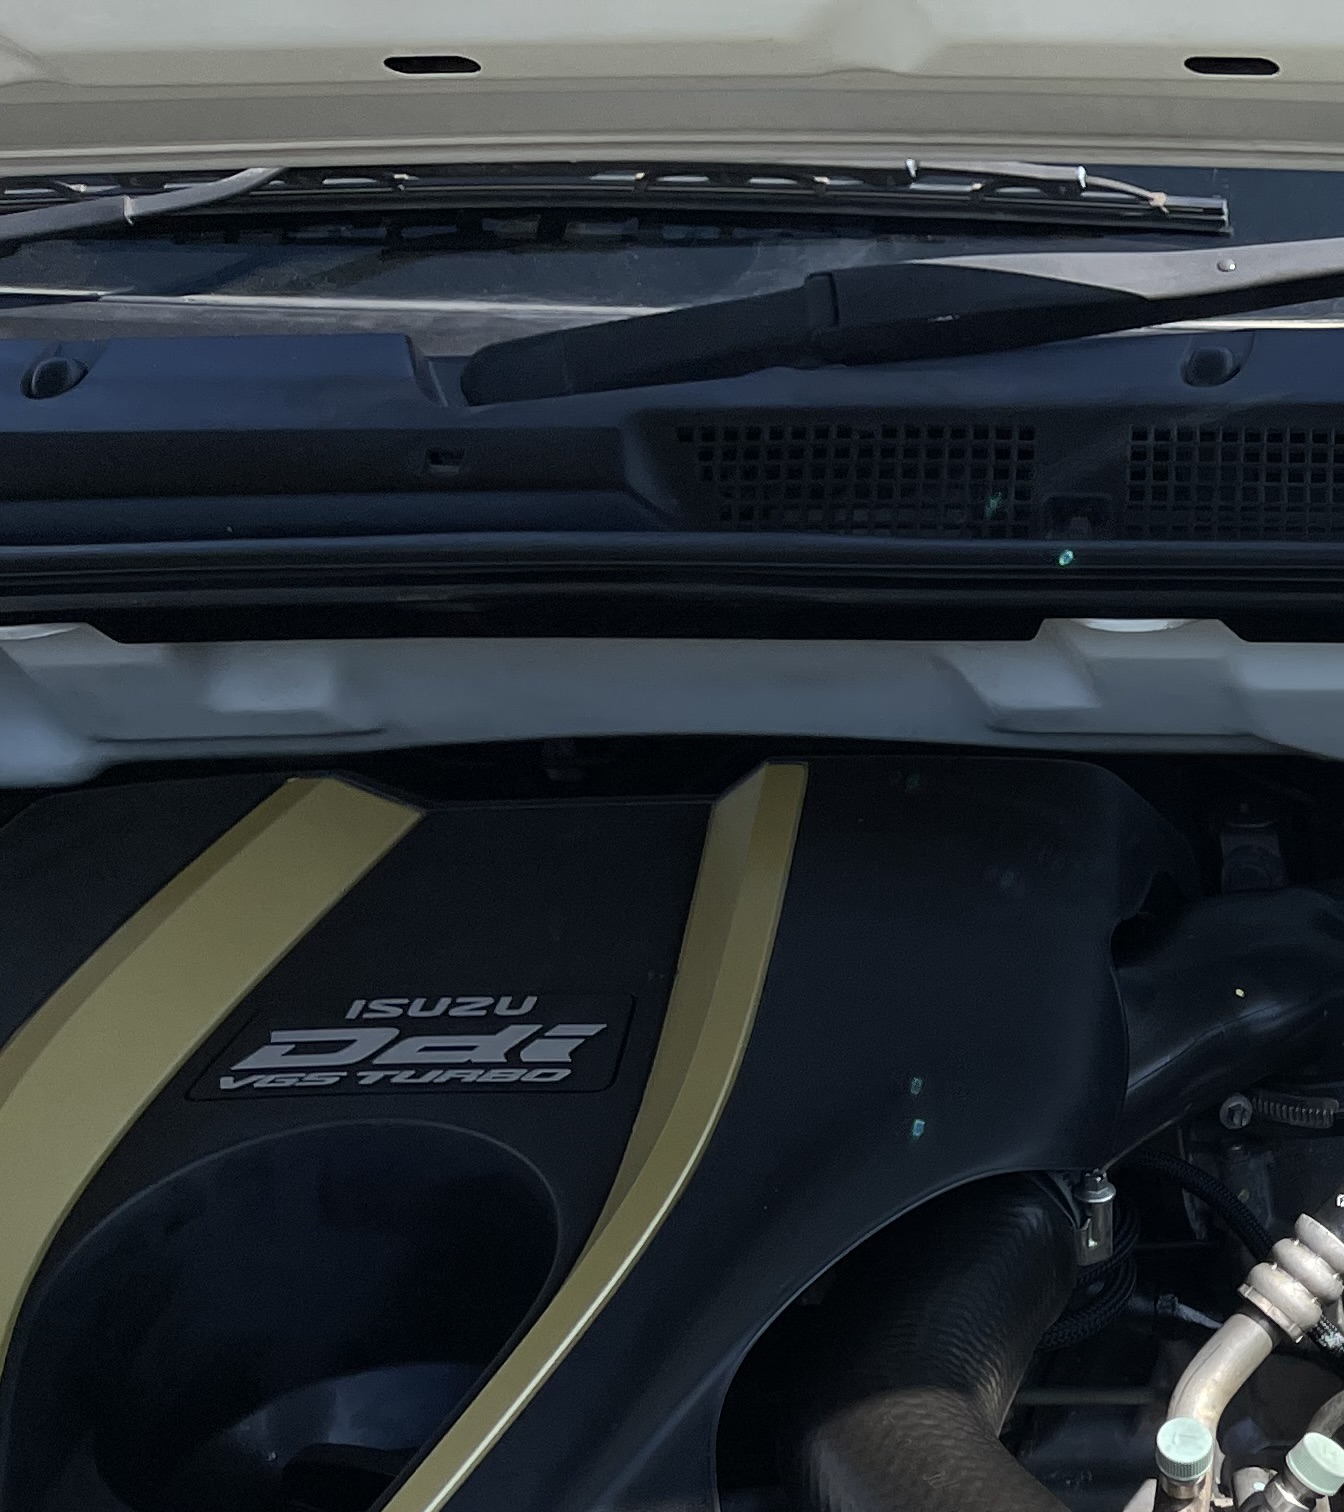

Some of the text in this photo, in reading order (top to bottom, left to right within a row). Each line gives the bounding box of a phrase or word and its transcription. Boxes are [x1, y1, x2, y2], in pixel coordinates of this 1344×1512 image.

[345, 996, 537, 1019] ISUZU
[220, 1068, 571, 1090] VGS TURBO
